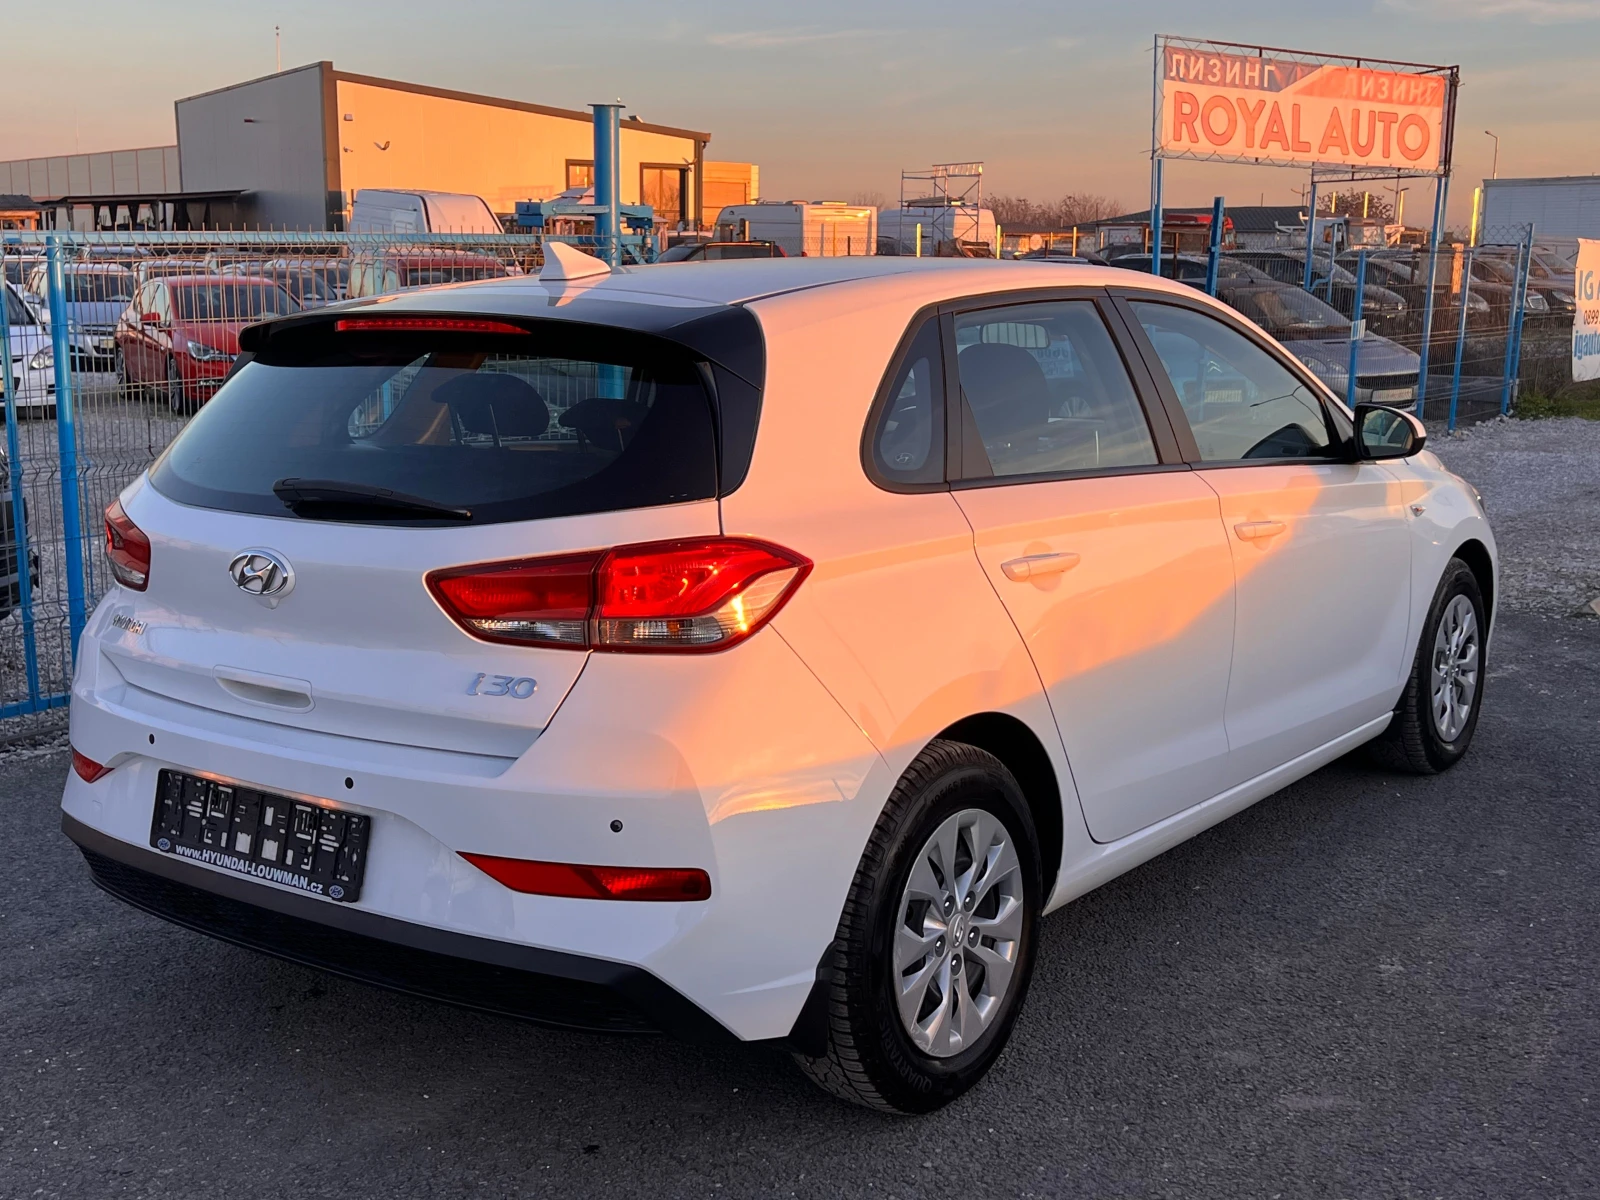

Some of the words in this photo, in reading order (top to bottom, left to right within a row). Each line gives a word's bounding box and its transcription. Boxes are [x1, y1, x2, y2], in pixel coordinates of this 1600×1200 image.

[1169, 54, 1276, 88] ЛИЗИНГ
[1341, 73, 1438, 105] ЛИЗИНГ
[1173, 91, 1311, 153] ROYAL
[1318, 106, 1430, 161] AUTO
[1578, 270, 1594, 301] IG
[175, 844, 324, 894] www.HYUNDAI-LOUWMAN.cz
